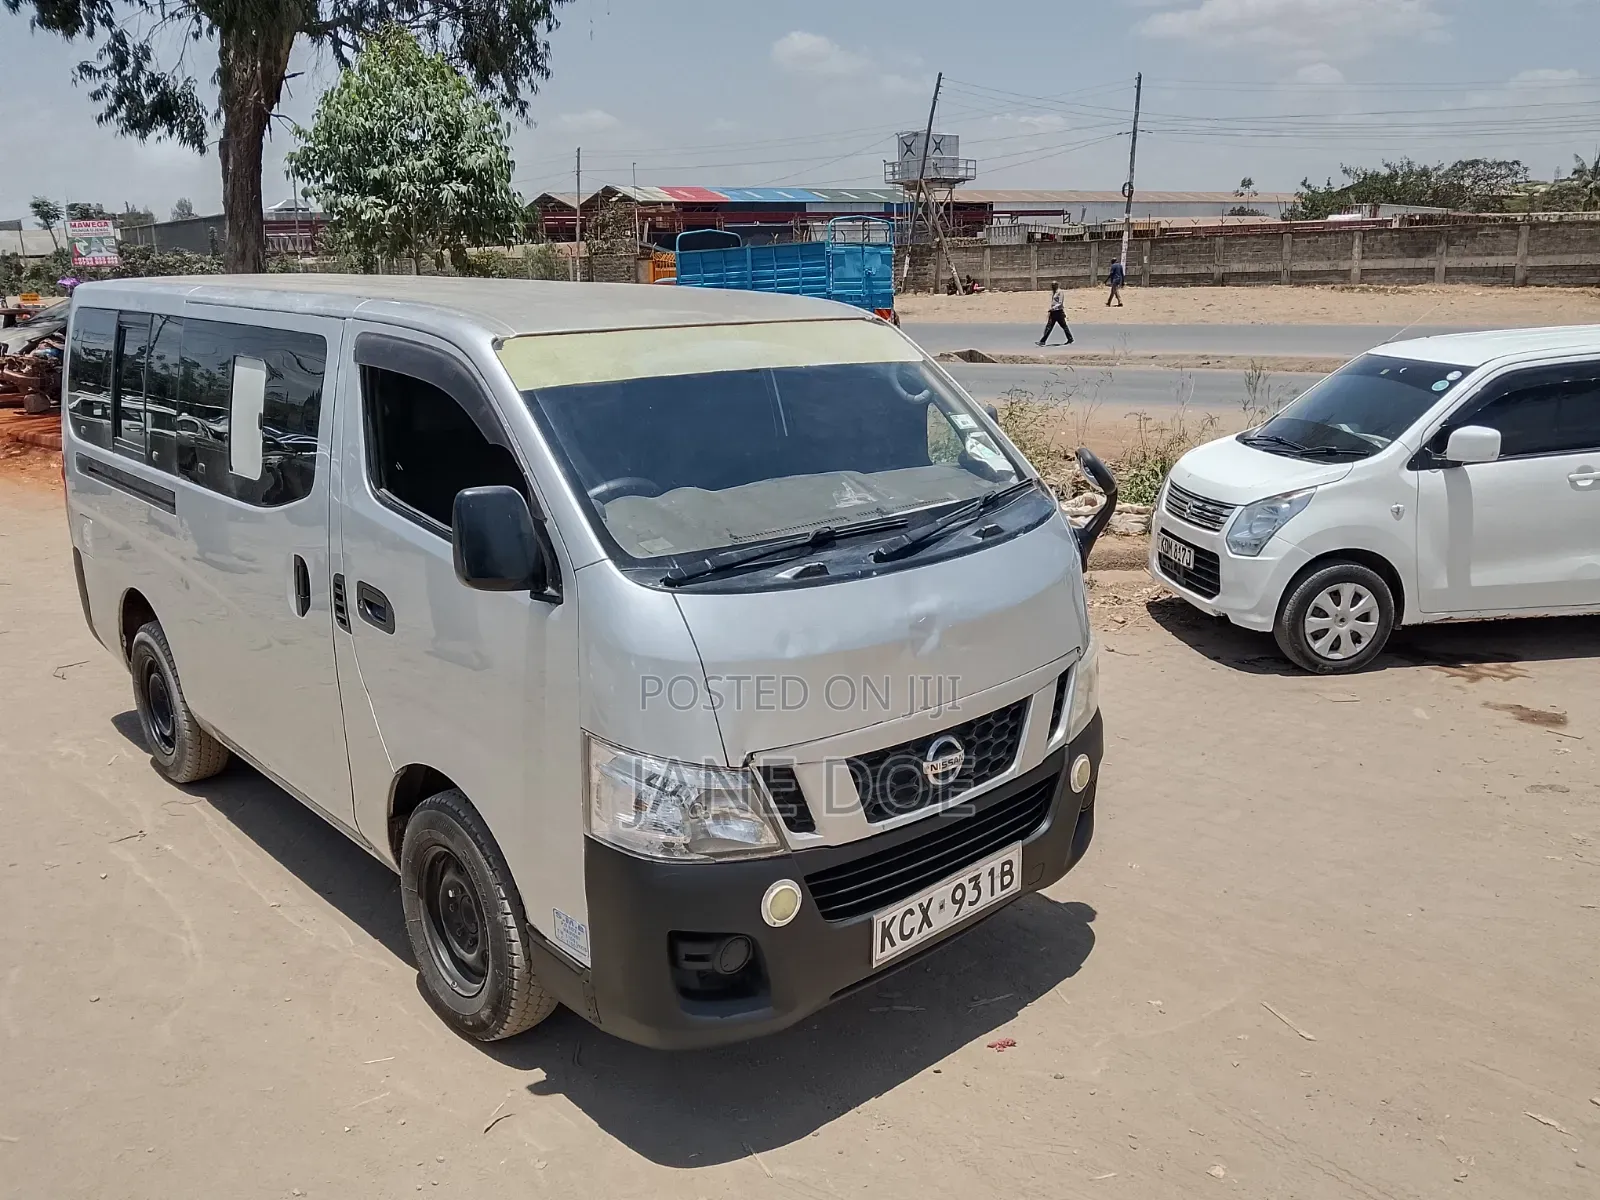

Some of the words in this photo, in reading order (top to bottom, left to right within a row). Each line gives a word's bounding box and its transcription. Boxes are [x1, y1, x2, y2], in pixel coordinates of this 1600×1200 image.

[70, 221, 109, 229] MAWEGA
[930, 752, 964, 772] NISSAN
[880, 897, 933, 953] KCX
[950, 859, 1015, 918] 931B
